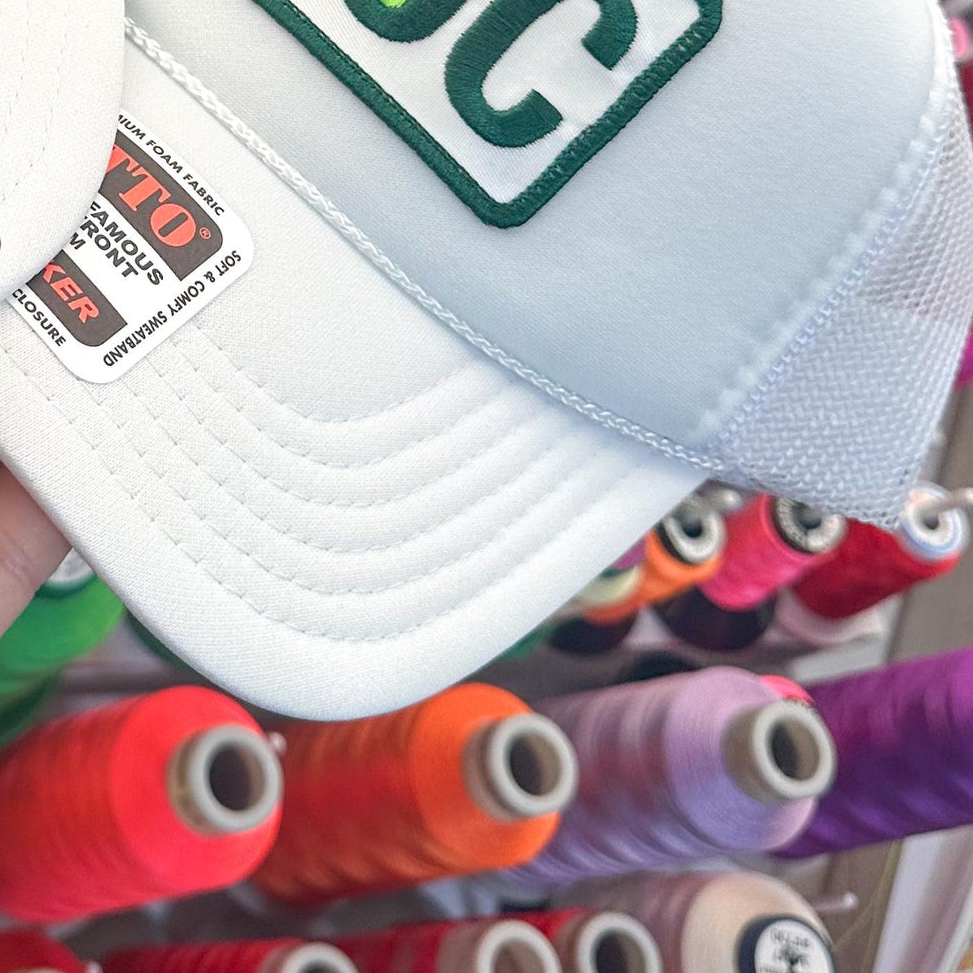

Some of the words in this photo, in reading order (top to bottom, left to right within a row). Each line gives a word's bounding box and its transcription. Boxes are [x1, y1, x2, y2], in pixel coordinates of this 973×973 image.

[146, 139, 184, 174] FOAM
[182, 173, 225, 216] FABRIC
[80, 215, 139, 278] RONT
[215, 250, 242, 277] SOFT
[167, 280, 205, 316] COMFY
[204, 270, 216, 283] &
[102, 310, 168, 367] SWEATBAND
